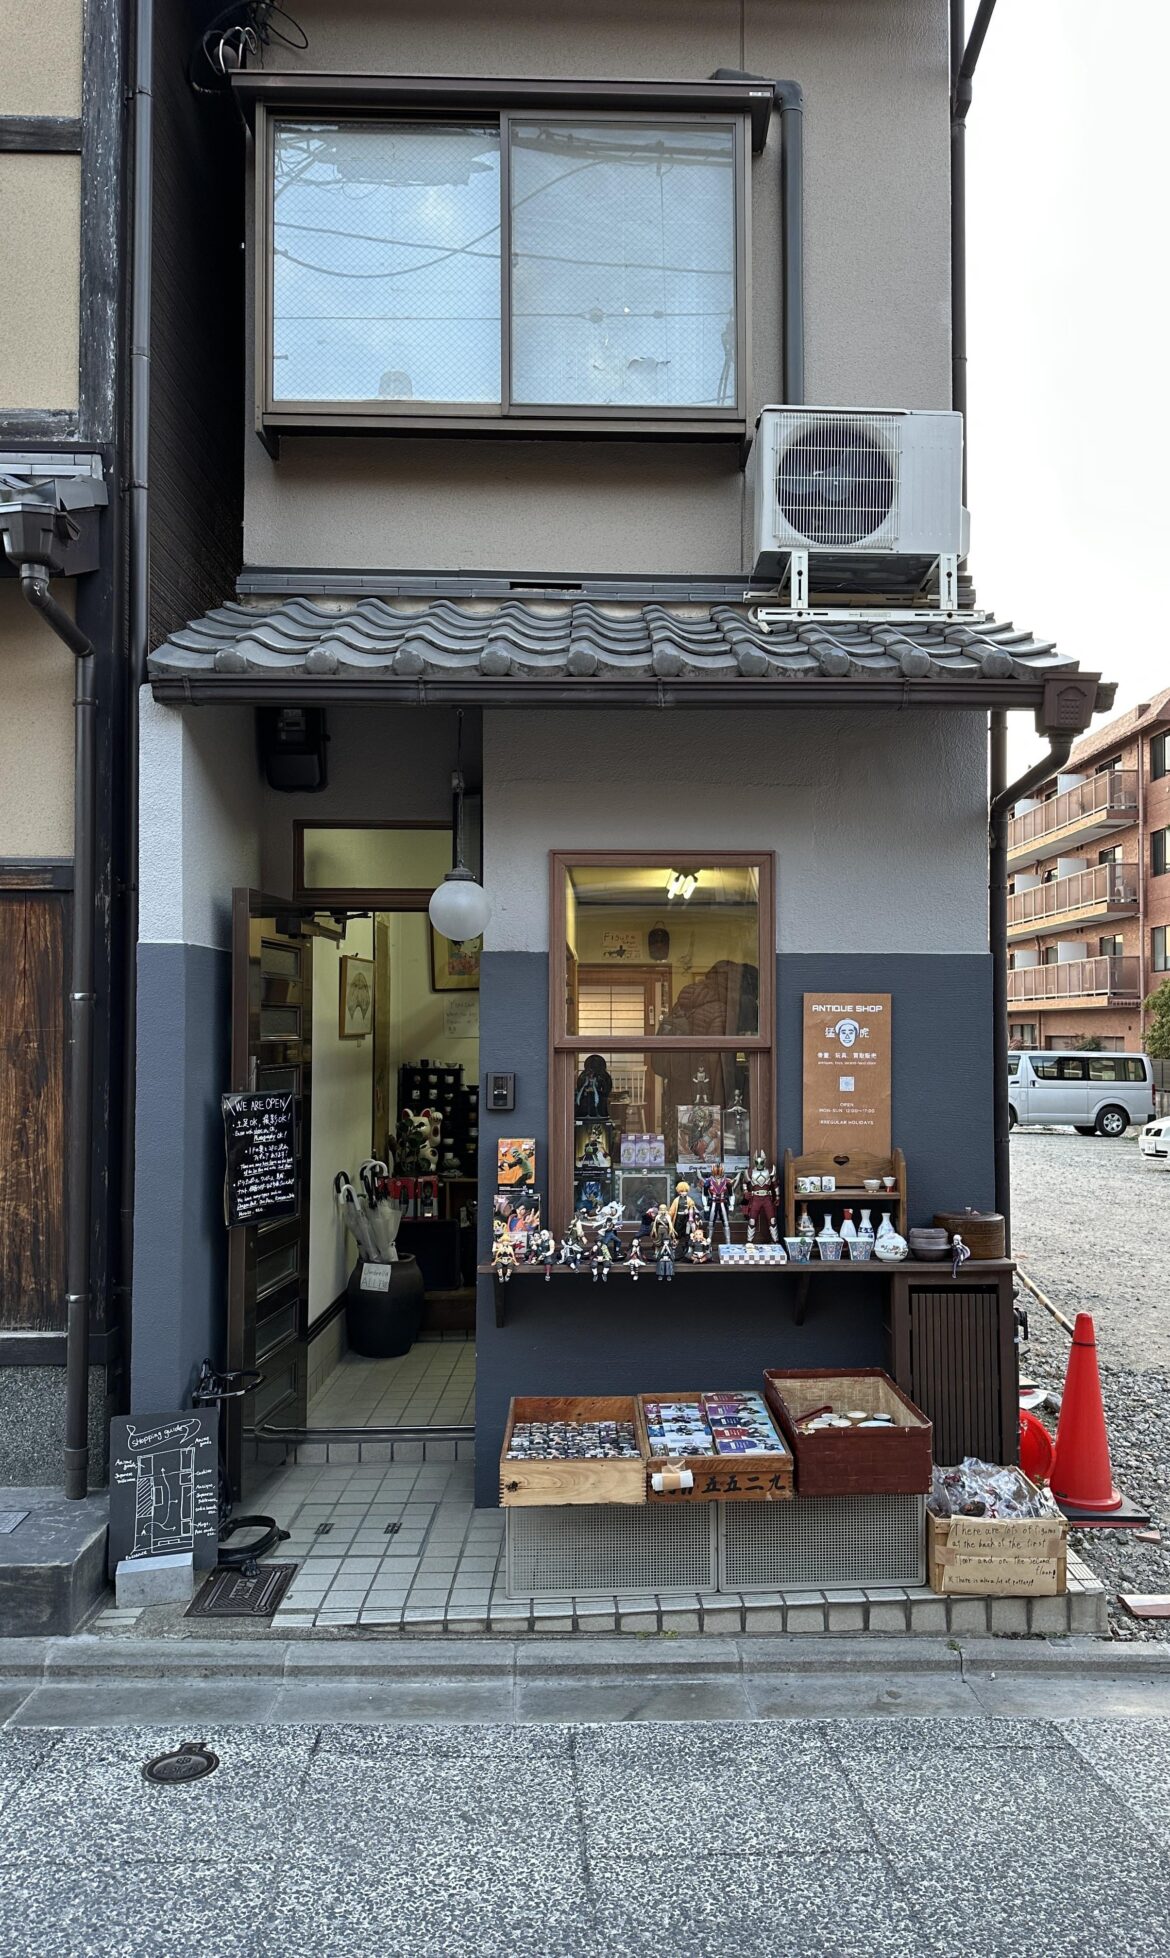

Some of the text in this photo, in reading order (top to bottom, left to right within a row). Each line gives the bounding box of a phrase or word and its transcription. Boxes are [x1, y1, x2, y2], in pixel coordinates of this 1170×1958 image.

[825, 1028, 870, 1038] 猛 虎
[234, 1097, 286, 1112] WE ARE OPEN
[164, 1425, 183, 1438] guide
[955, 1523, 982, 1536] There
[1022, 1525, 1032, 1534] of
[964, 1540, 976, 1549] the
[998, 1538, 1005, 1548] of
[1009, 1537, 1022, 1549] the
[978, 1555, 994, 1564] and
